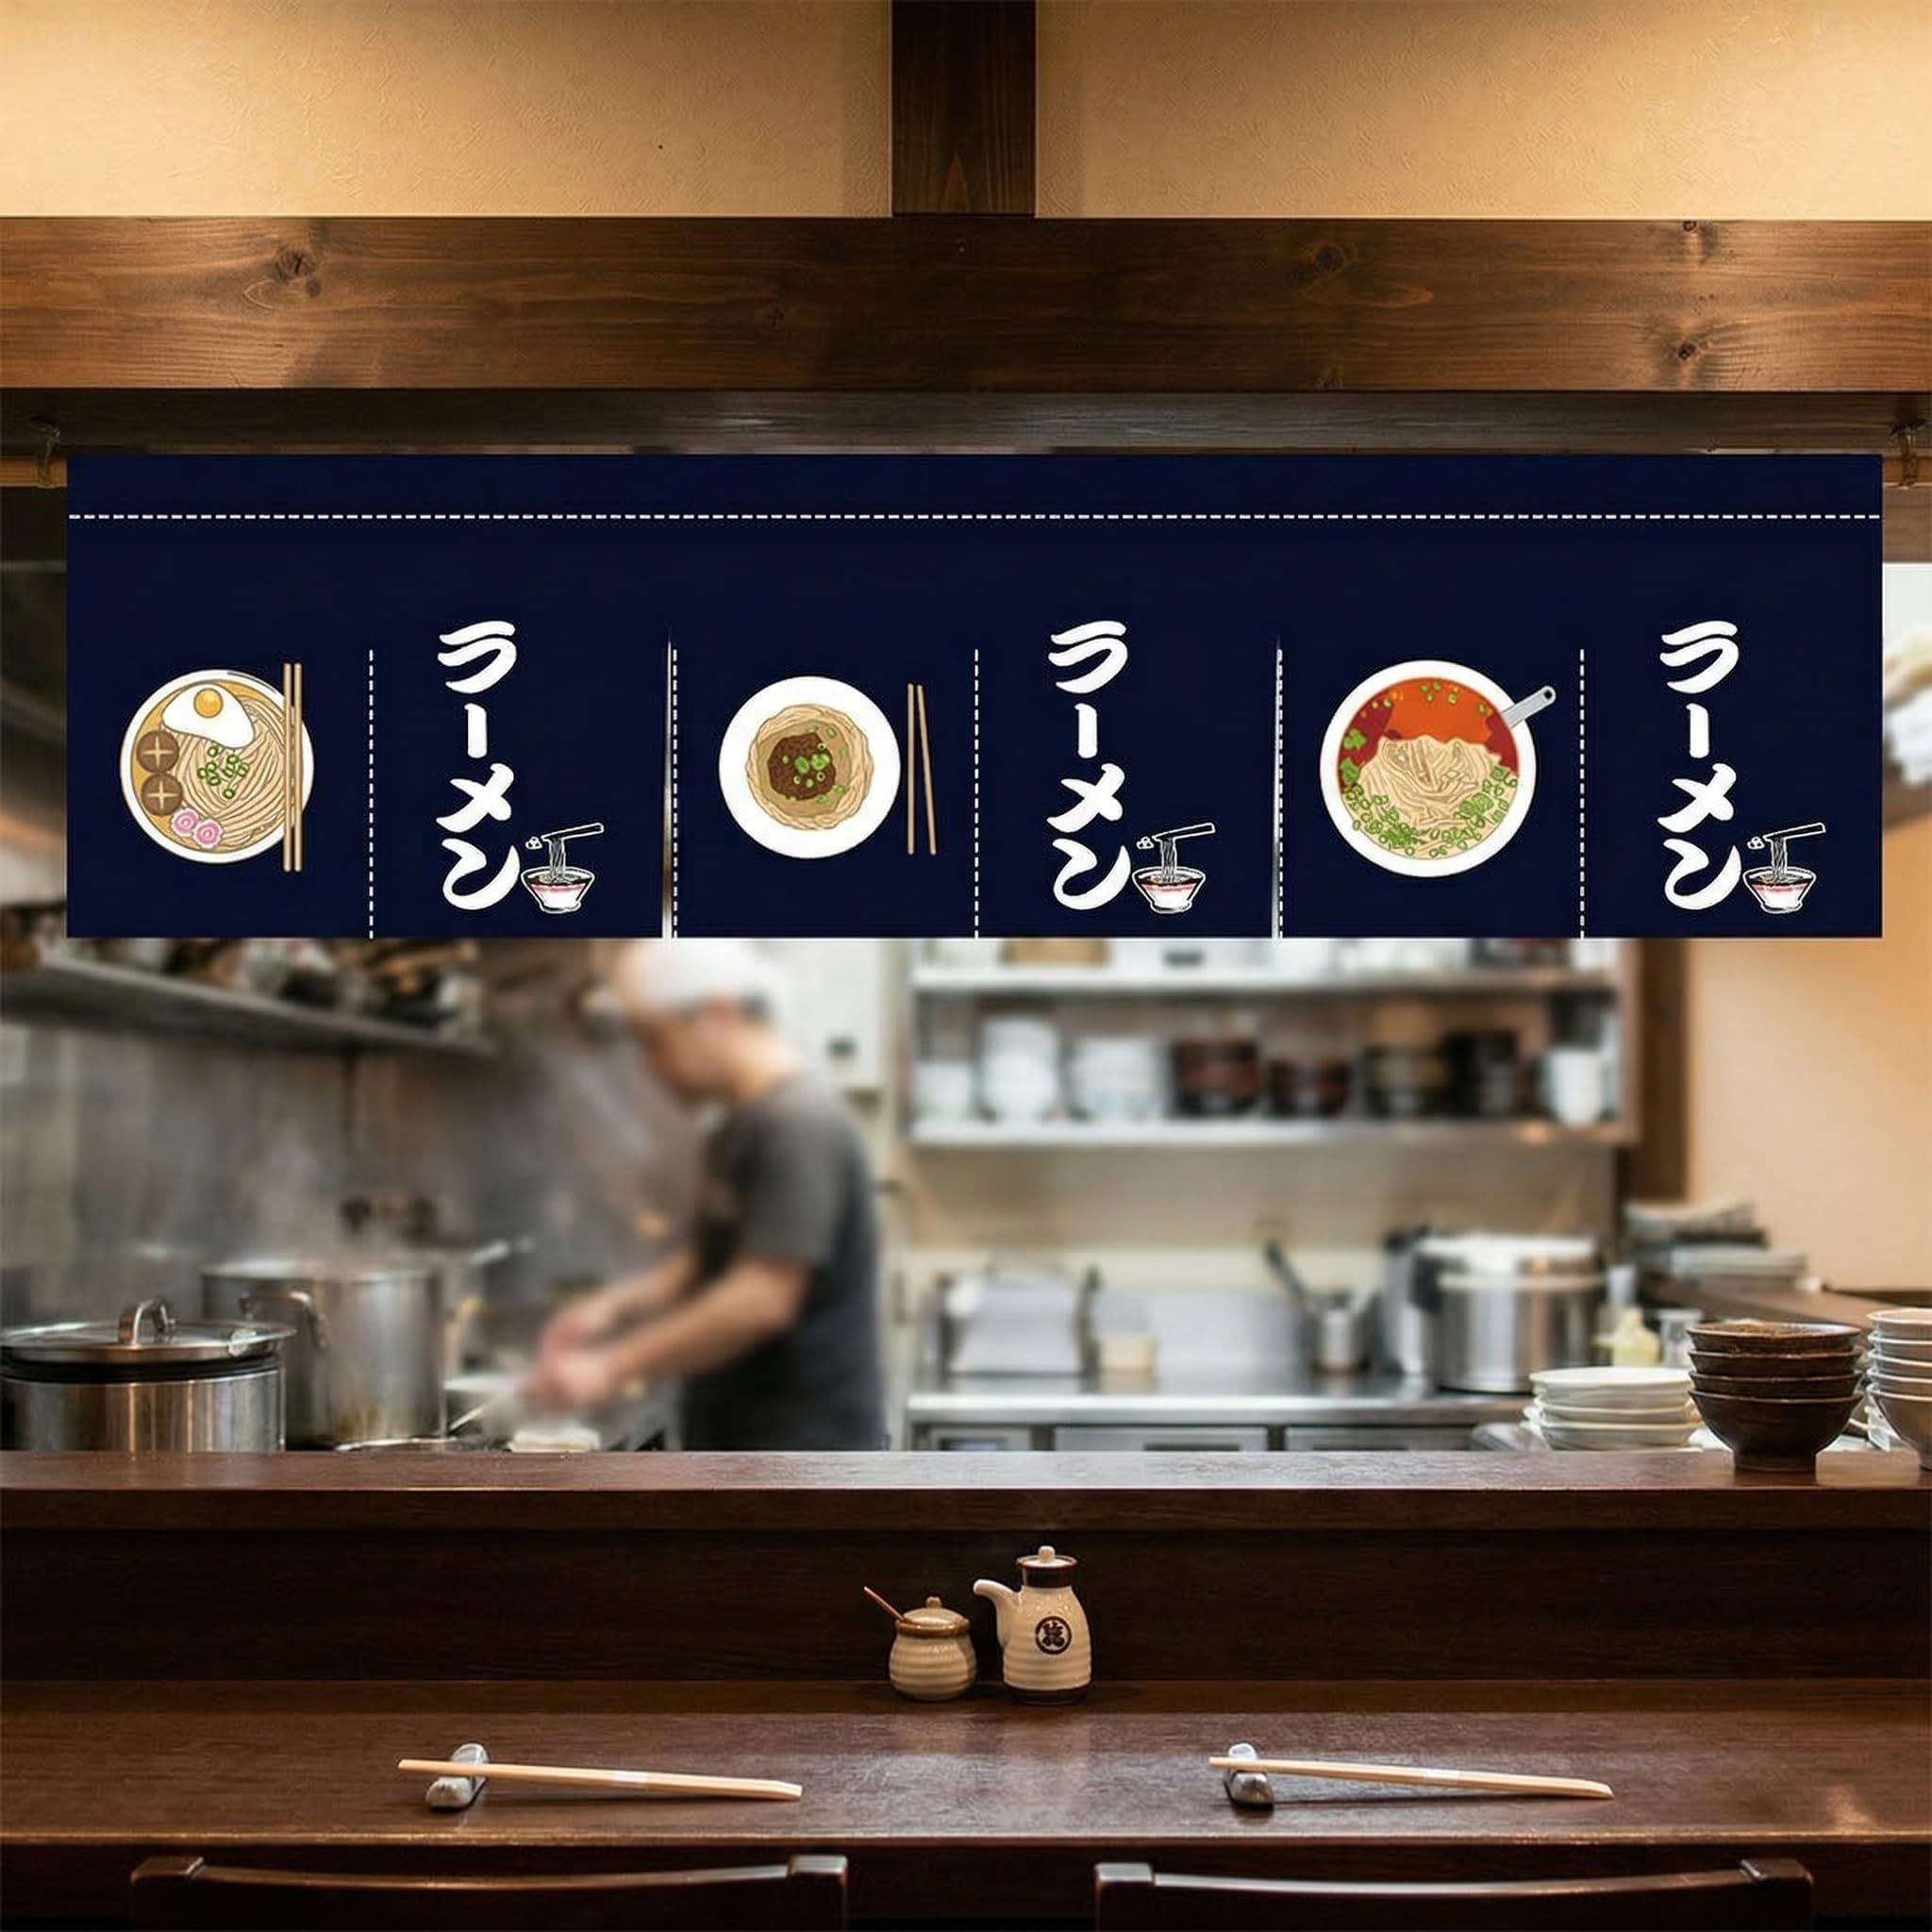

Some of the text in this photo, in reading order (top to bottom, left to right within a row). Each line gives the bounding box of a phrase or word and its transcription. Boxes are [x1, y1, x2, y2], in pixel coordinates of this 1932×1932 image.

[436, 620, 521, 910] ラーメン
[1046, 620, 1132, 910] ラーメン
[1657, 620, 1743, 910] ラーメン
